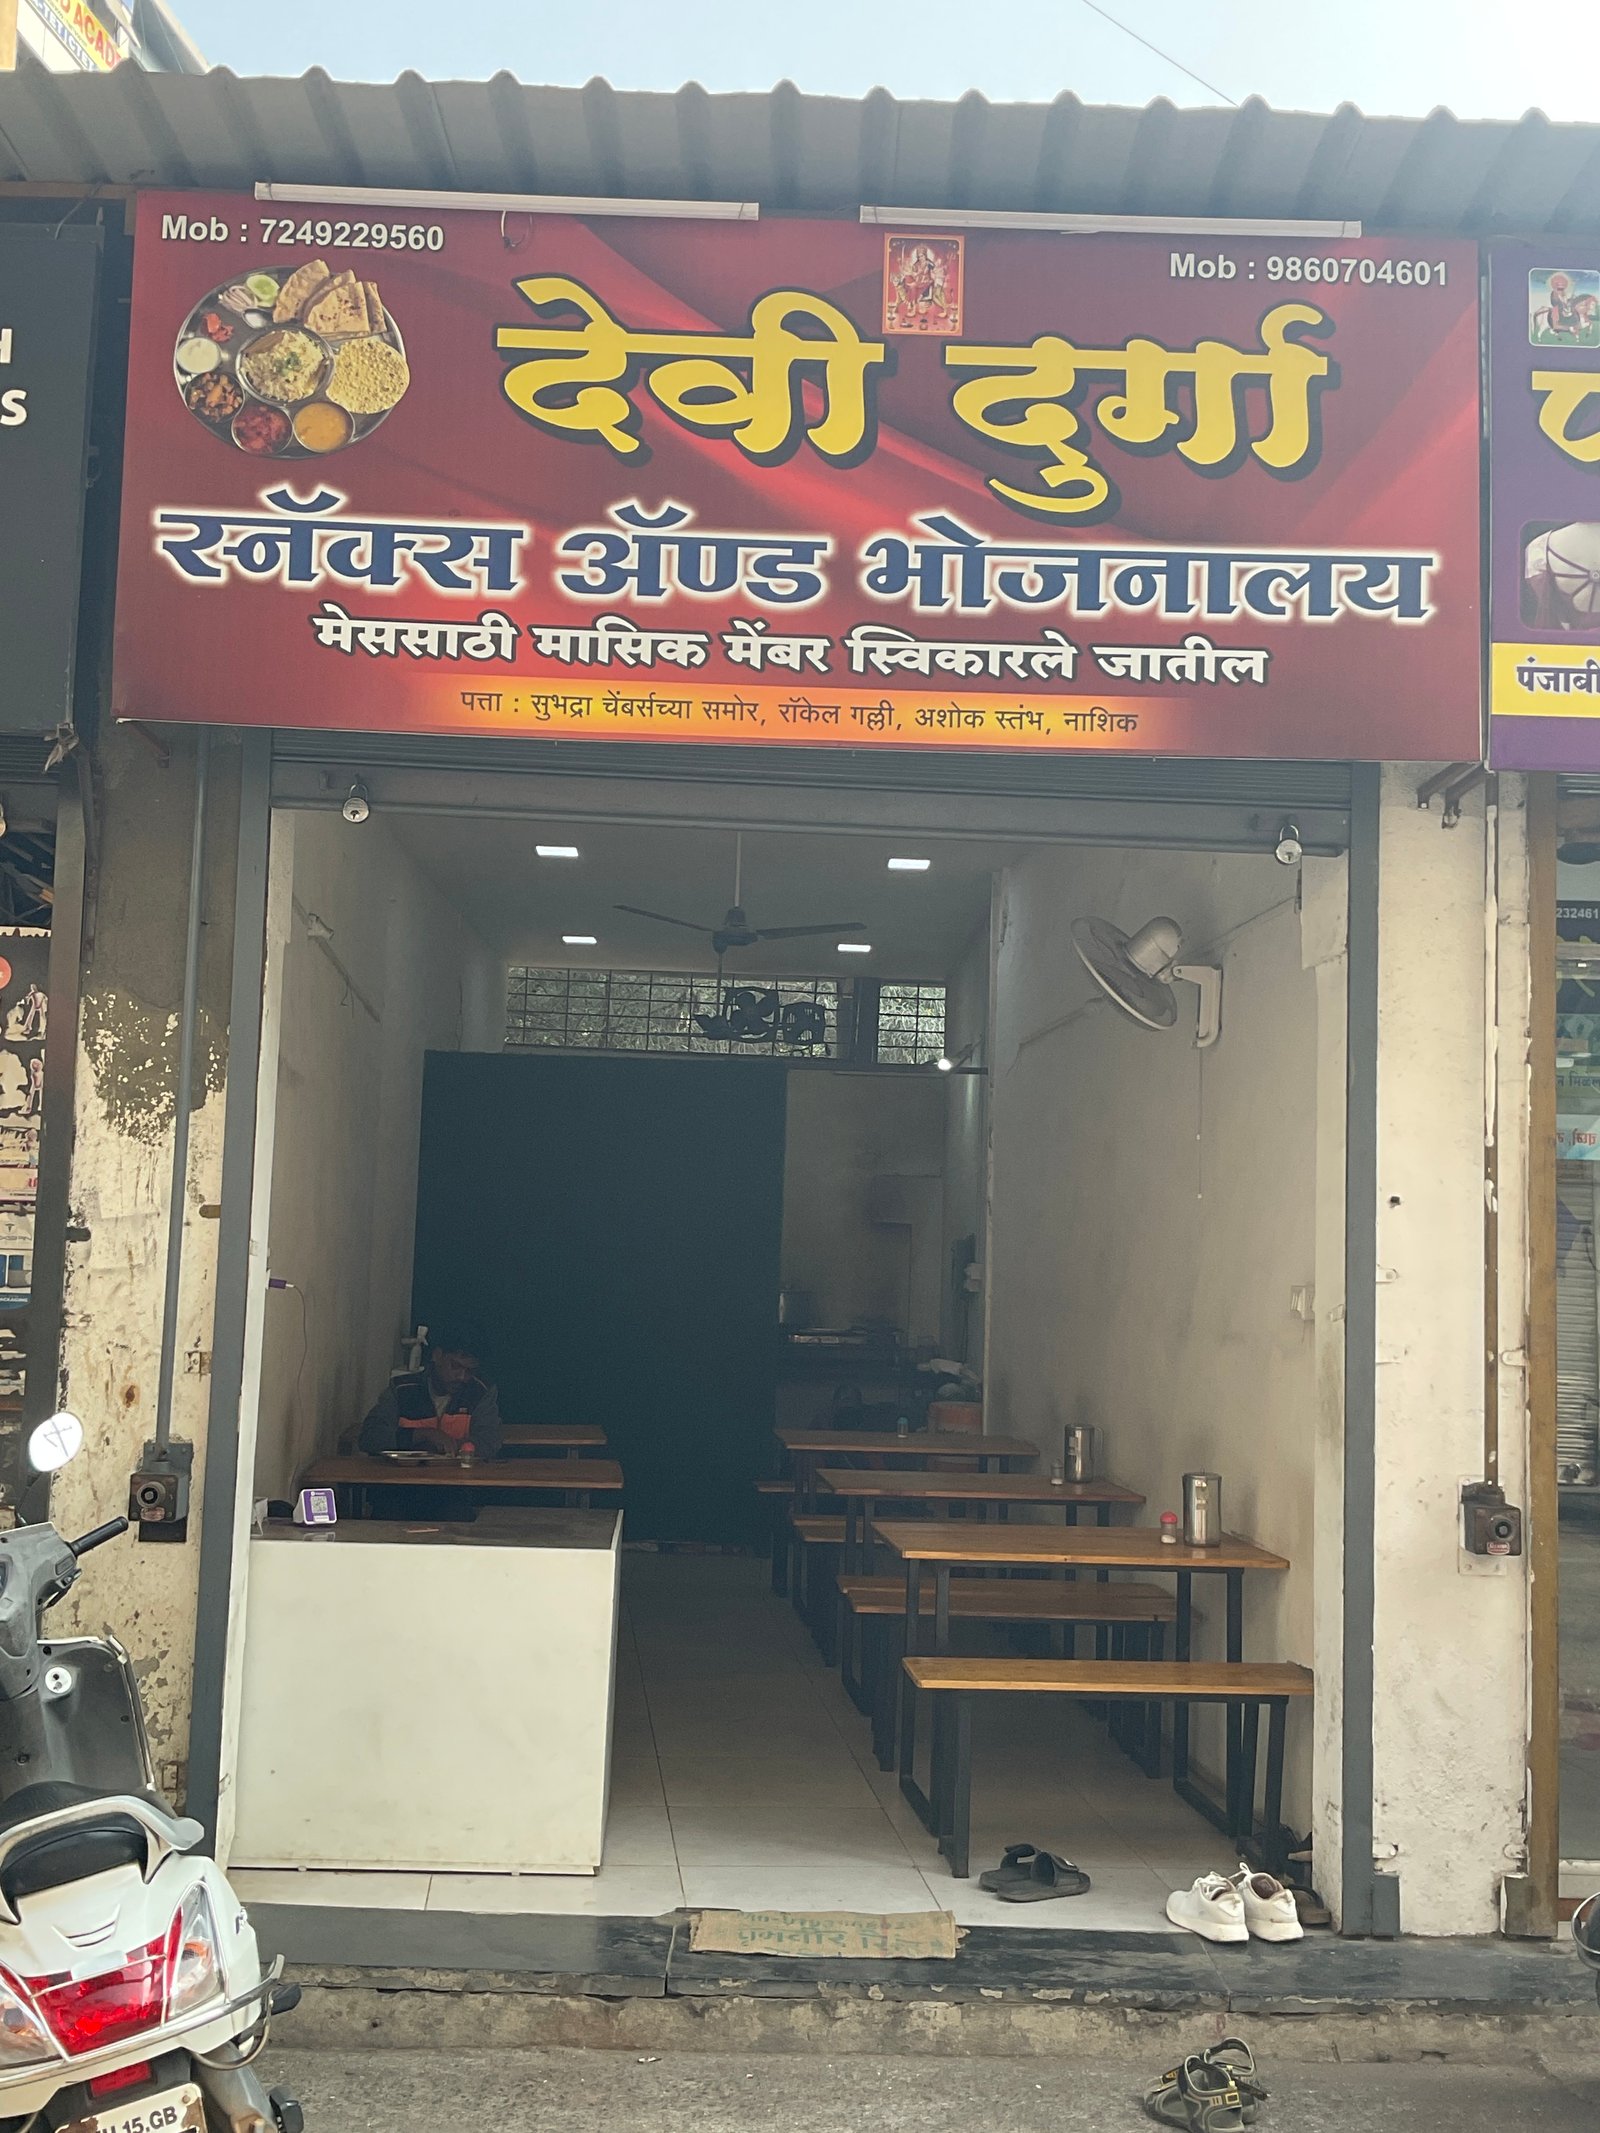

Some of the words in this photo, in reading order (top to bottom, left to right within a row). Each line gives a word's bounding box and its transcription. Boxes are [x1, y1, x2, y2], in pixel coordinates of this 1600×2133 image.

[161, 215, 229, 242] Mob
[259, 218, 444, 251] 7249229560
[1170, 253, 1237, 279] Mob
[1266, 256, 1446, 286] 9860704601
[496, 276, 886, 455] देवी
[945, 303, 1329, 513] दुर्गा
[159, 489, 525, 592] स्नॅक्स
[865, 515, 1434, 618] भोजनालय
[312, 603, 518, 660] मेससाठी
[532, 615, 708, 667] मासिक
[722, 618, 830, 671] मेंबर
[845, 624, 1079, 680] स्विकारले
[1092, 635, 1268, 684] जातील
[1516, 656, 1600, 694] पंजाबी
[460, 690, 503, 712] पत्ता
[530, 693, 593, 721] सुभद्रा
[602, 690, 693, 719] चेंबर्सच्या
[702, 694, 766, 727] समोर,
[778, 697, 841, 724] रॉकेल
[850, 699, 902, 731] गल्ली,
[914, 701, 986, 729] अशोक
[995, 703, 1052, 736] स्तंभ,
[1063, 706, 1139, 733] नाशिक
